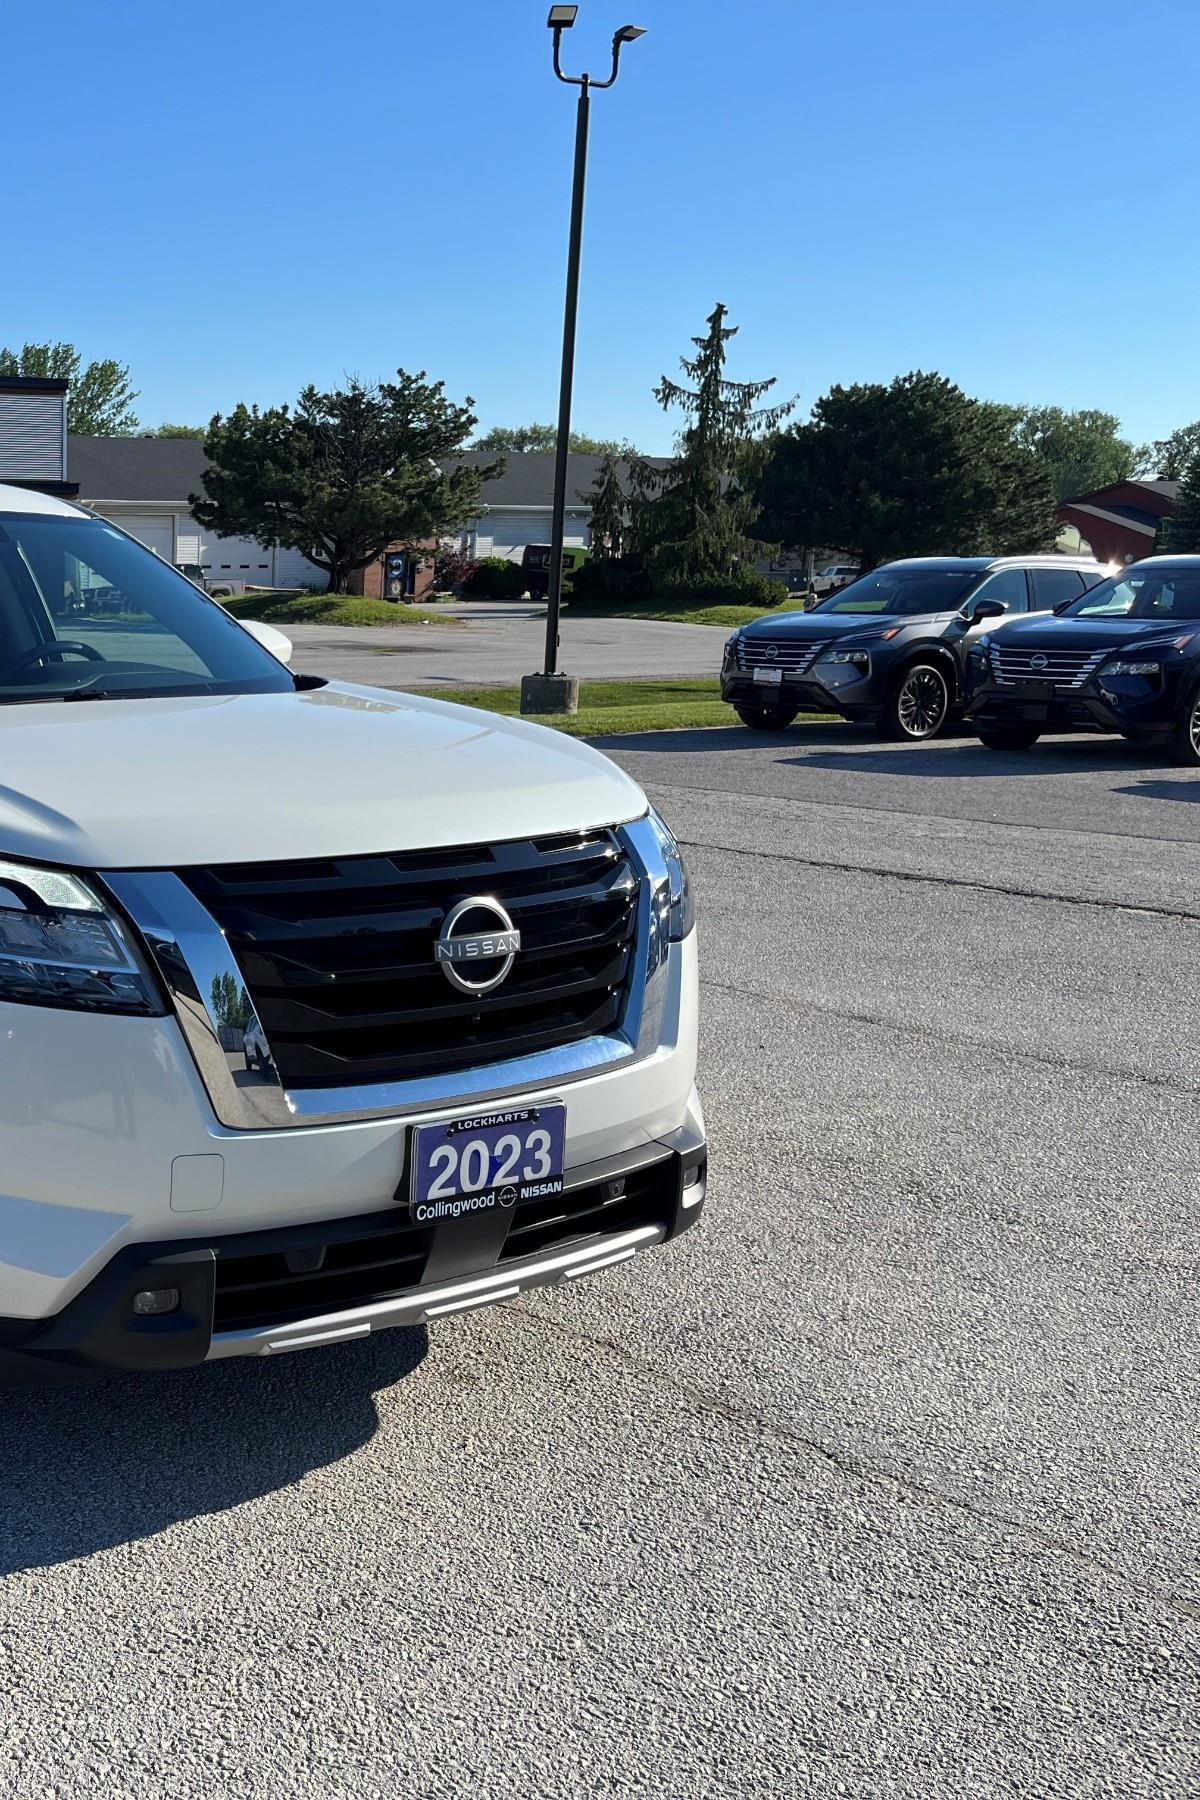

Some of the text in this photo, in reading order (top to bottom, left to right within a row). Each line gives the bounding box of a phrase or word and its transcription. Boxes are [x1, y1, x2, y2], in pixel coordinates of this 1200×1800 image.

[437, 935, 519, 958] NISSAN
[427, 1129, 551, 1200] 2023
[416, 1192, 495, 1221] Collingwood
[520, 1181, 562, 1199] NISSAN
